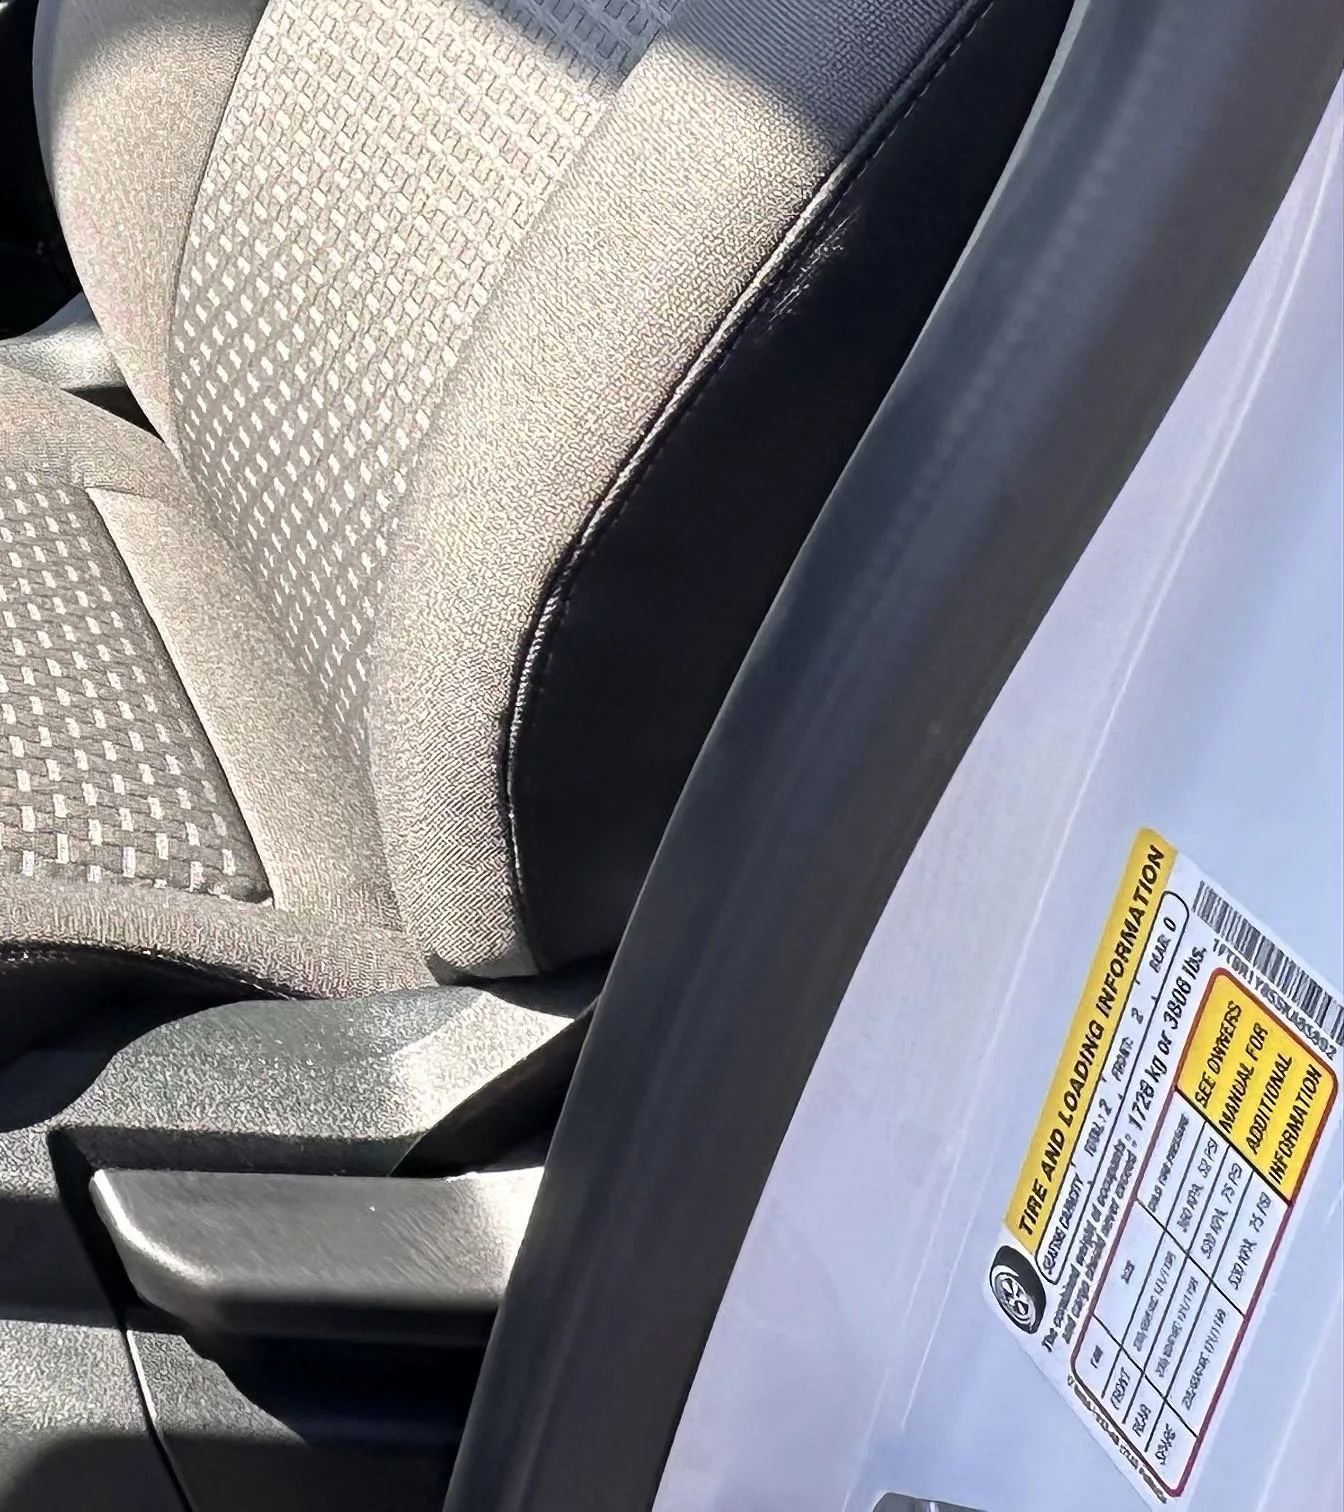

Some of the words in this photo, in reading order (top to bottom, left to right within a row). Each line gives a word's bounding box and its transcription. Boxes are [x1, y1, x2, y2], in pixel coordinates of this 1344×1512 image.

[1019, 1178, 1048, 1236] TIRE
[1041, 1128, 1065, 1183] AND
[1058, 1019, 1105, 1128] LOADING
[1095, 843, 1166, 1019] INFORMATION
[1144, 1055, 1168, 1084] kg
[1157, 1030, 1173, 1056] or
[1194, 1071, 1216, 1109] SEE
[1207, 1000, 1242, 1075] OWNERS
[1218, 1062, 1254, 1134] MANUAL
[1245, 1021, 1269, 1061] FOR
[1246, 1052, 1292, 1155] ADDITIONAL
[1268, 1063, 1323, 1185] INFORMATION
